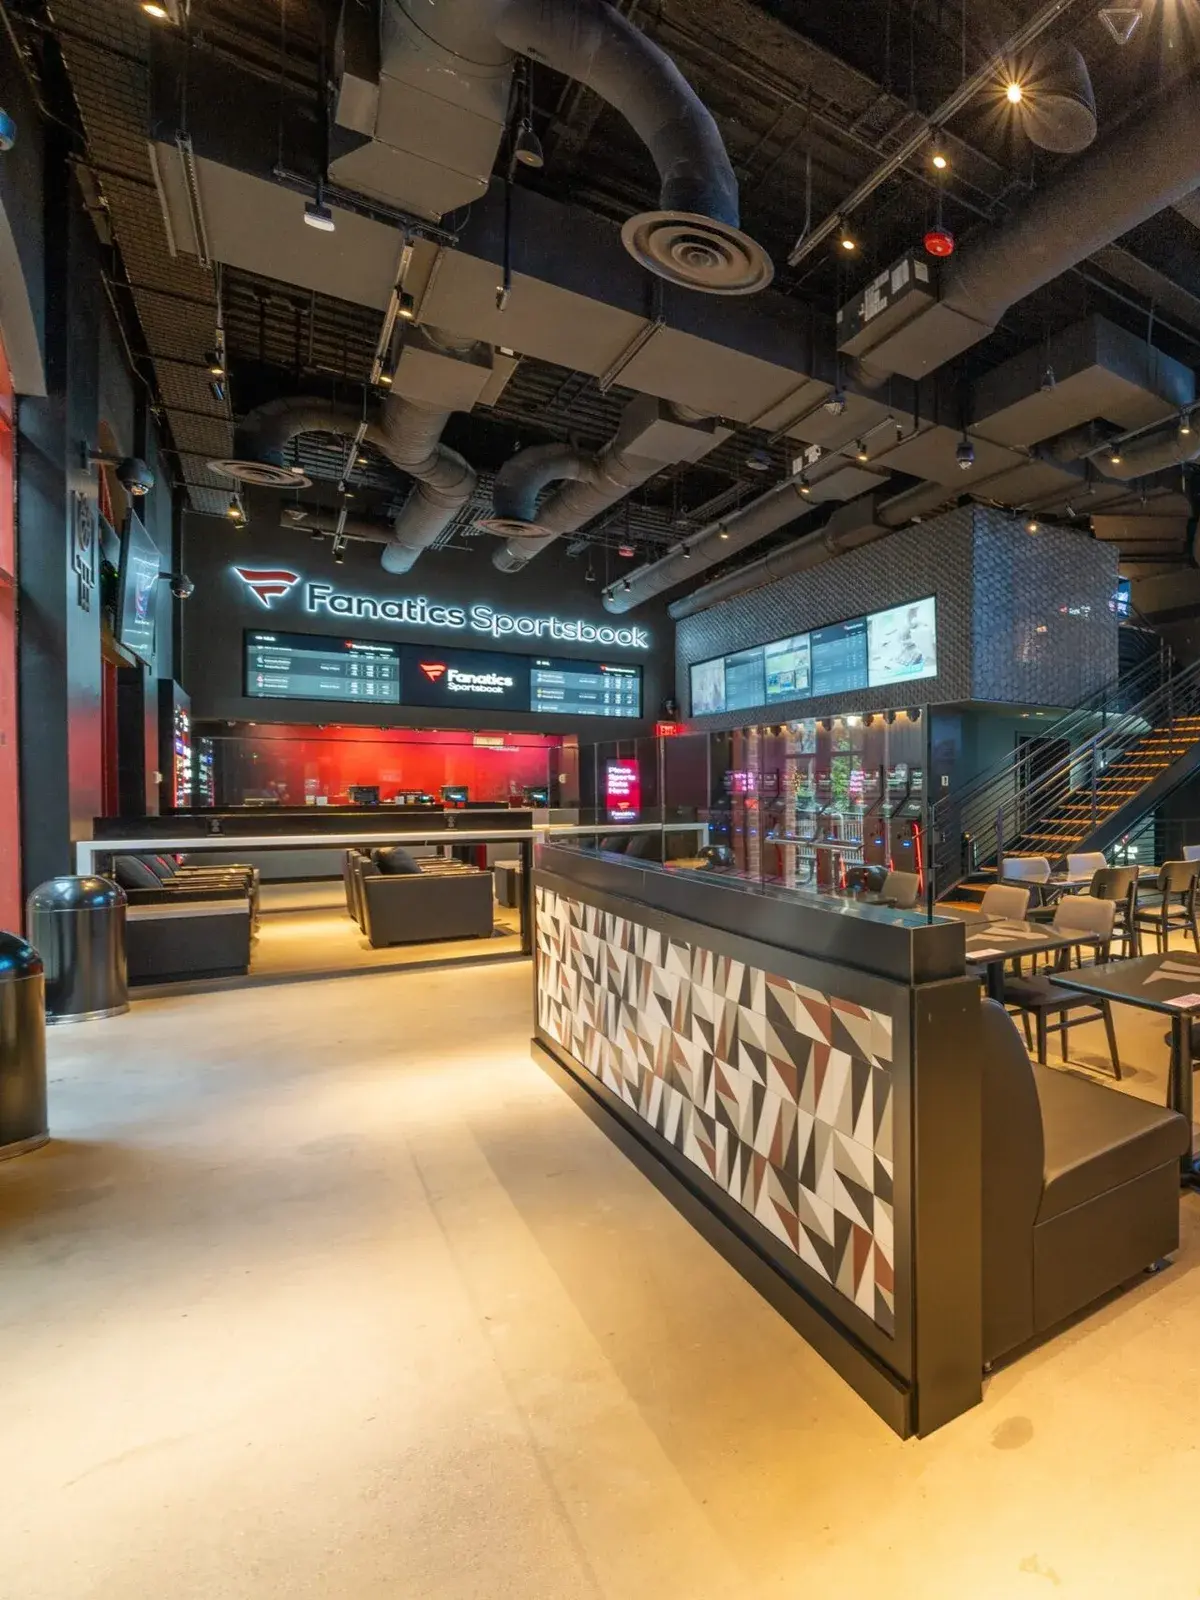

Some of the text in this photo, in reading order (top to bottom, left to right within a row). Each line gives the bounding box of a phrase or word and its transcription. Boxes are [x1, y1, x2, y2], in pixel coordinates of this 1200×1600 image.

[307, 583, 649, 649] Fanatics Sportsbook
[447, 669, 514, 687] Fanatics
[447, 682, 504, 693] Sportsbook
[608, 766, 632, 774] Place
[608, 773, 636, 781] Sports
[608, 780, 628, 788] Bets
[608, 787, 630, 795] Here
